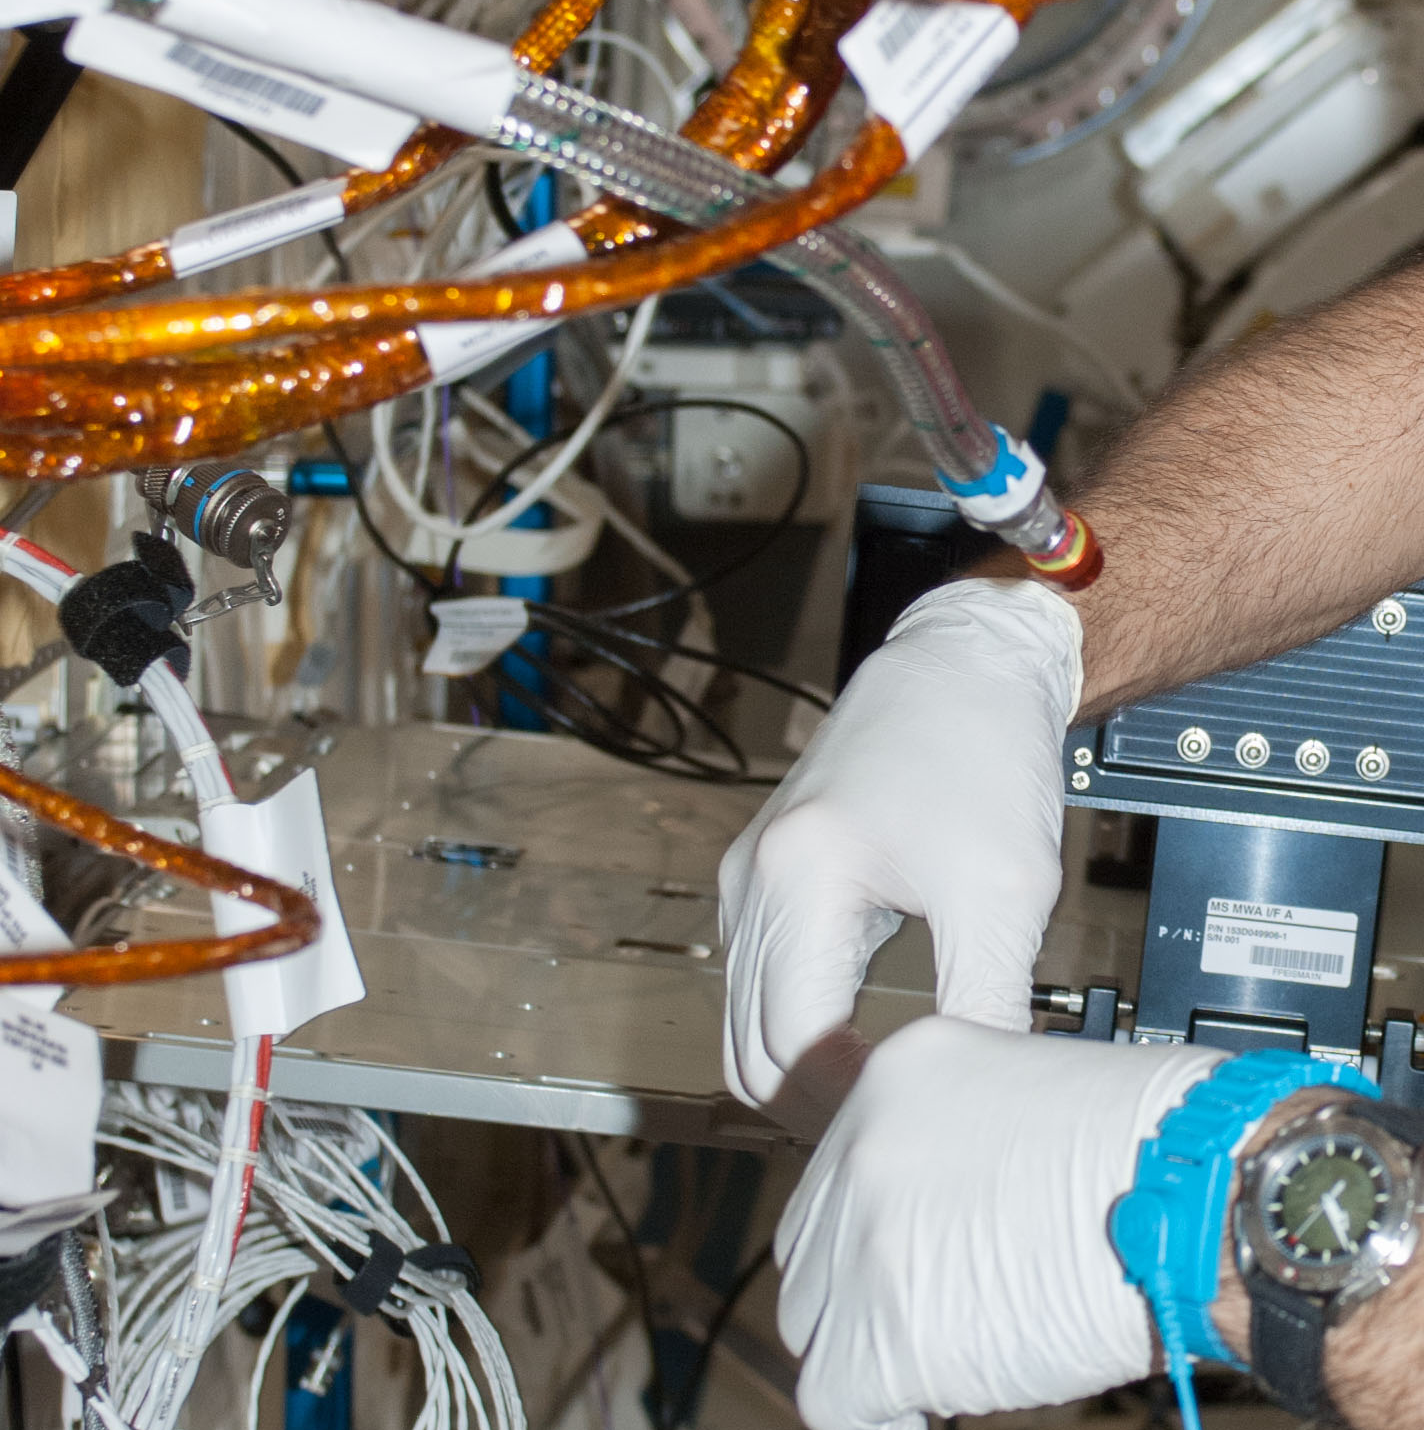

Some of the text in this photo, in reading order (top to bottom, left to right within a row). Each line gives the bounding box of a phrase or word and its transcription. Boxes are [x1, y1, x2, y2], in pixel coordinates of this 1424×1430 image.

[1210, 900, 1294, 920] MS MWA I/F A
[1207, 923, 1223, 934] P/N
[1206, 933, 1240, 945] S/N 001
